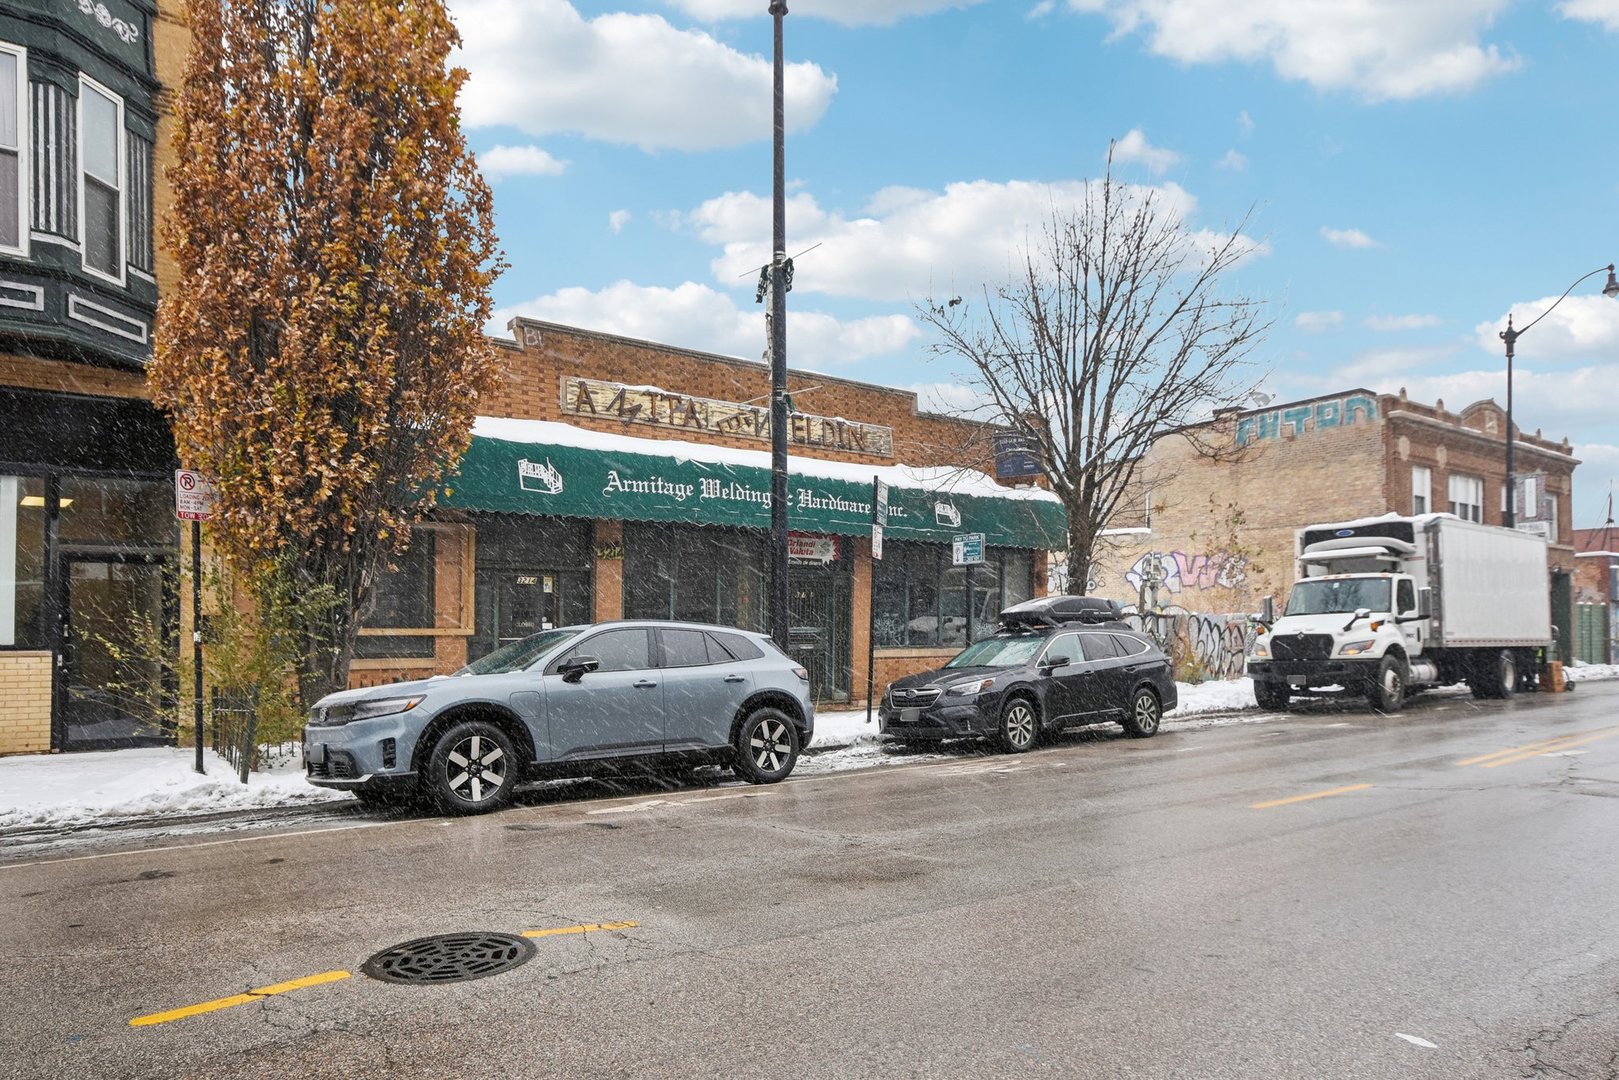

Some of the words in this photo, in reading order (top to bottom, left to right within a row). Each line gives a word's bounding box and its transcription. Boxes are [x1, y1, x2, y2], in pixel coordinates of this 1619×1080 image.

[602, 470, 694, 502] Armitage
[699, 477, 772, 509] Welding
[796, 488, 871, 513] Hardware
[888, 505, 908, 518] nc.
